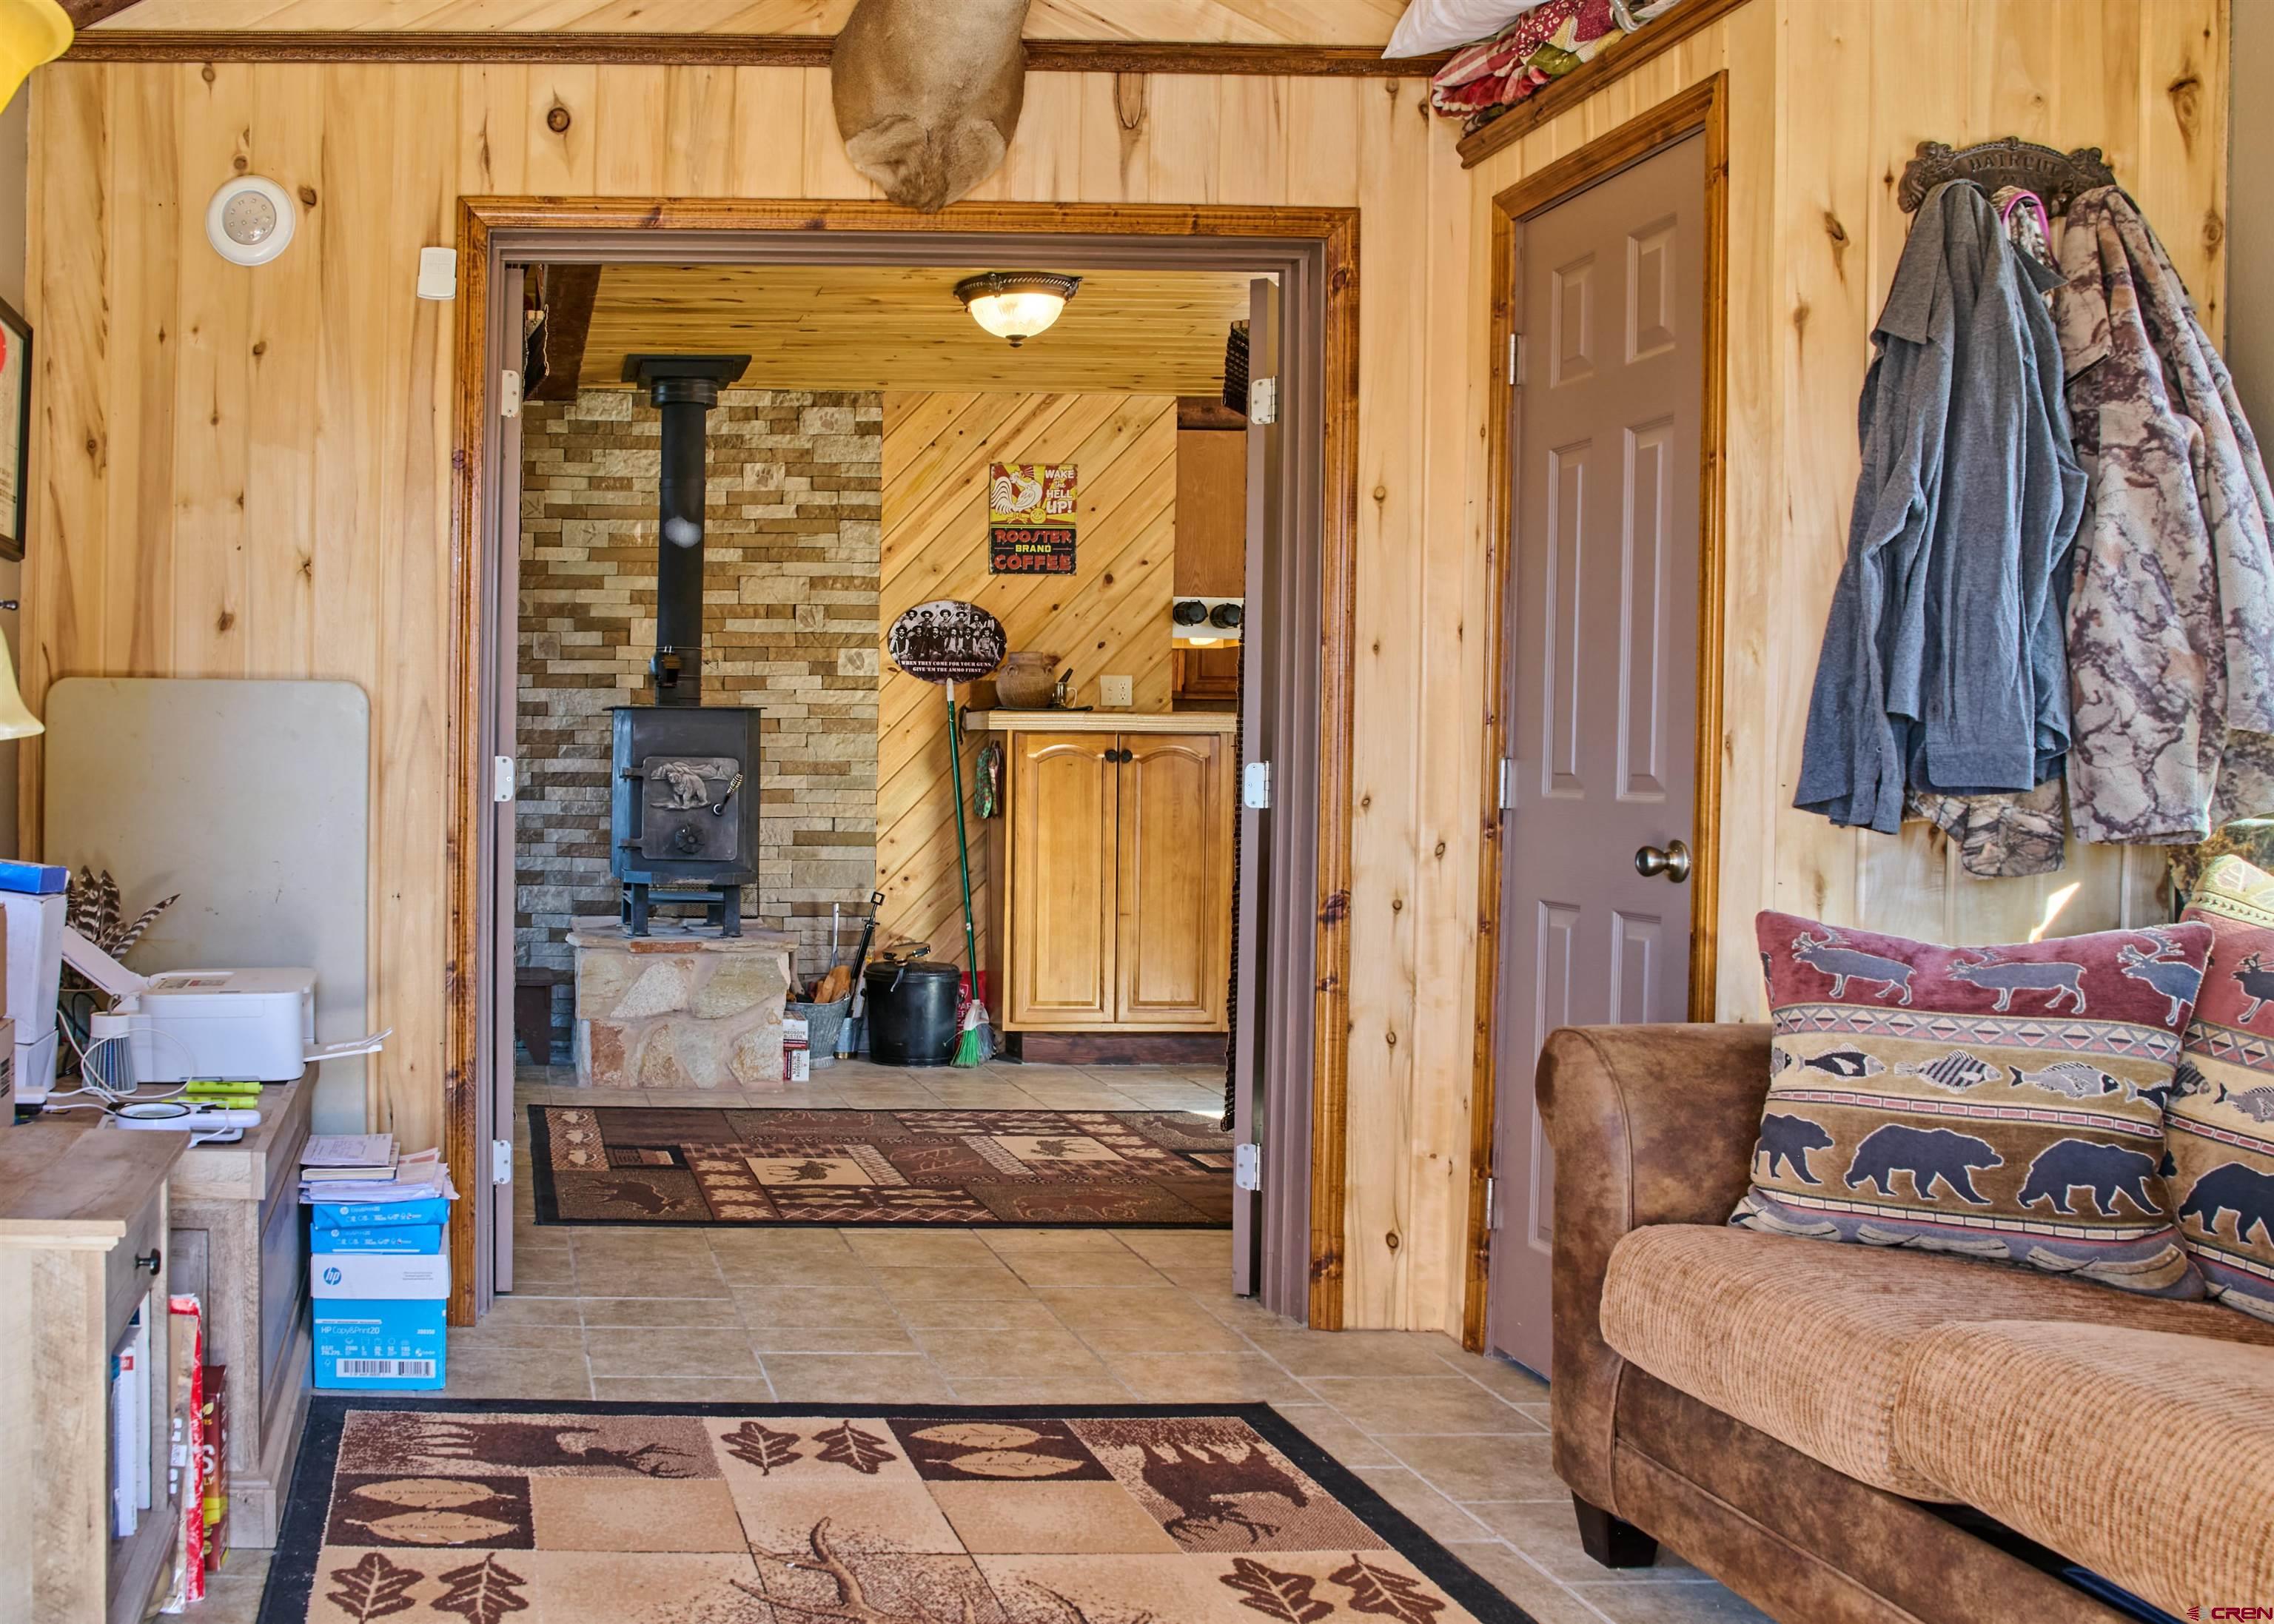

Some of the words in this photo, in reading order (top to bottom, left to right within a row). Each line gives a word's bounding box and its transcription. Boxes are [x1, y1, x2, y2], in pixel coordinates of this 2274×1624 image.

[1969, 153, 2059, 176] HAIRCUT
[1044, 469, 1074, 479] WAKE
[1046, 489, 1073, 498] HELL
[1046, 500, 1073, 514] UP!
[995, 530, 1072, 543] ROOSTER
[994, 554, 1072, 571] COFFEE
[323, 1267, 341, 1285] hp
[332, 1326, 380, 1335] Copy&Print20
